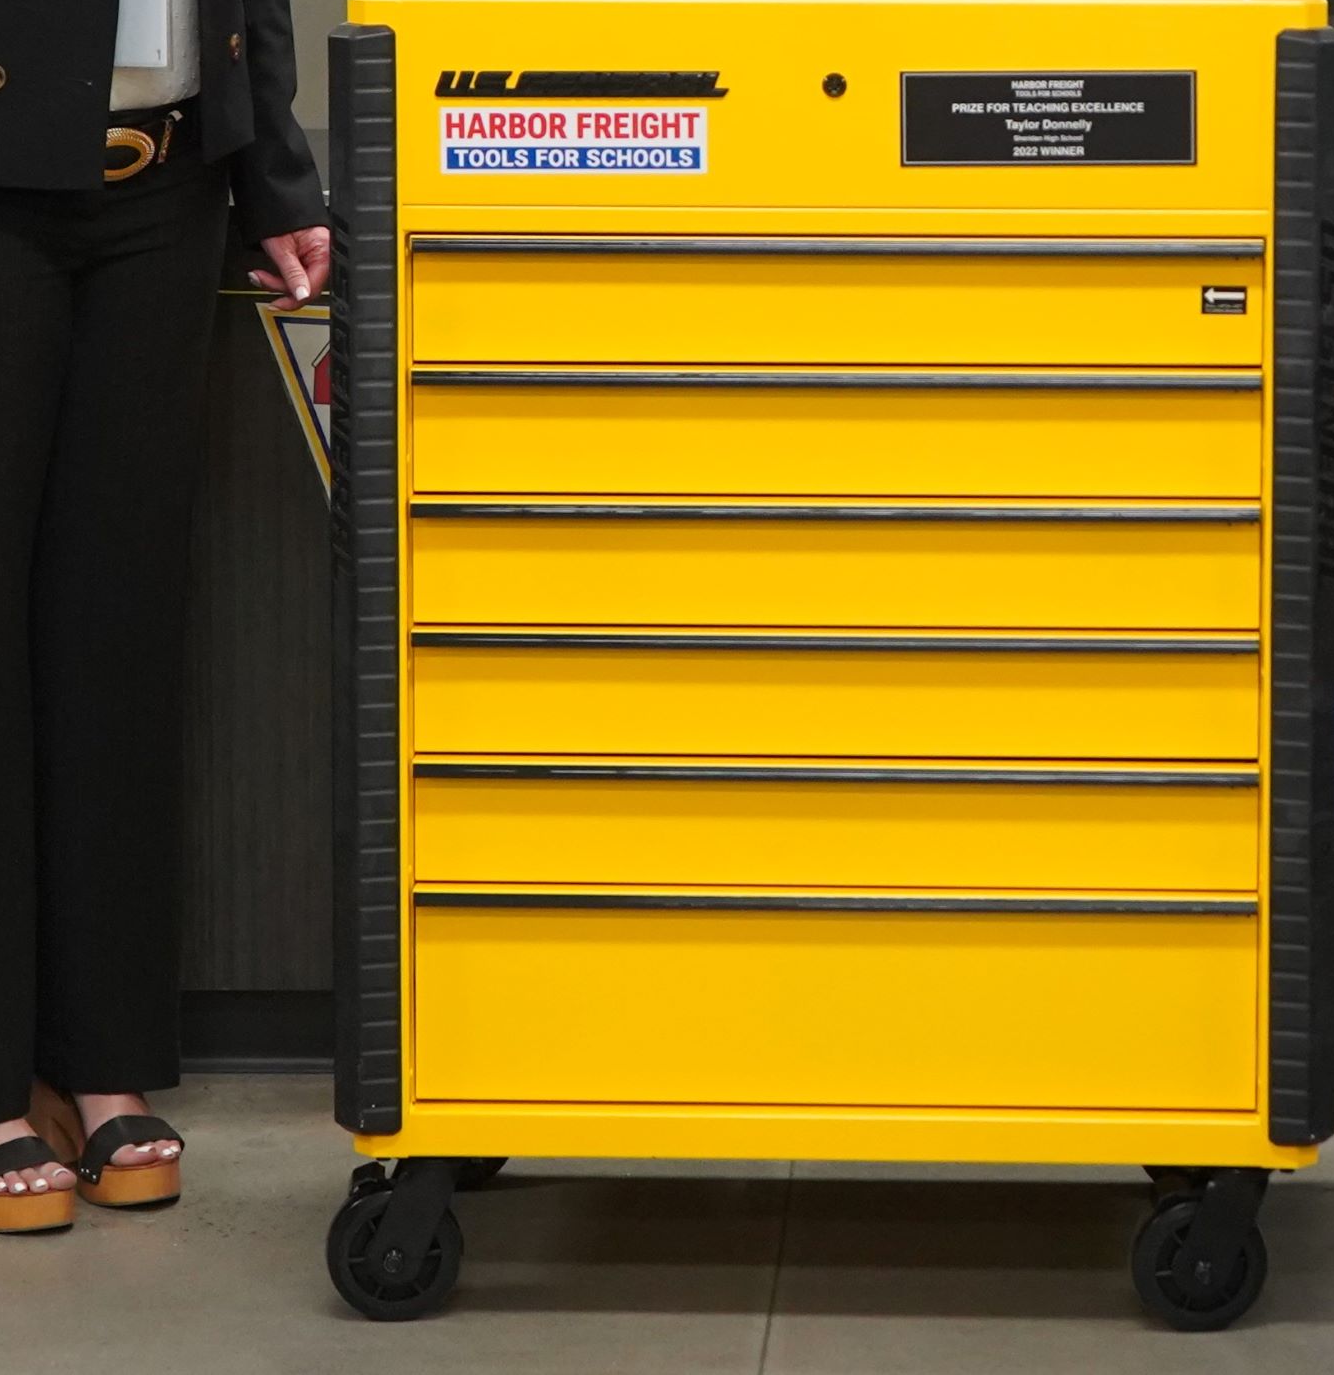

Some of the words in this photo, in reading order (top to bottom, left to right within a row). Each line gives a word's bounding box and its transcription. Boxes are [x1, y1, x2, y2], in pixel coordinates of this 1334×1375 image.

[1011, 80, 1048, 89] HARBOR
[1048, 80, 1085, 89] FREIGHT
[951, 102, 985, 113] PRIZE
[986, 102, 1011, 113] FOR
[1012, 102, 1069, 113] TEACHING
[1071, 102, 1145, 113] EXCELLENCE
[445, 112, 568, 139] HARBOR
[576, 112, 701, 139] FREIGHT
[1005, 118, 1040, 132] Taylor
[1042, 118, 1093, 132] Donnelly
[1013, 146, 1039, 157] 2022
[1040, 146, 1085, 157] WINNER
[454, 149, 529, 167] TOOLS
[535, 149, 580, 167] FOR
[586, 149, 693, 167] SCHOOLS
